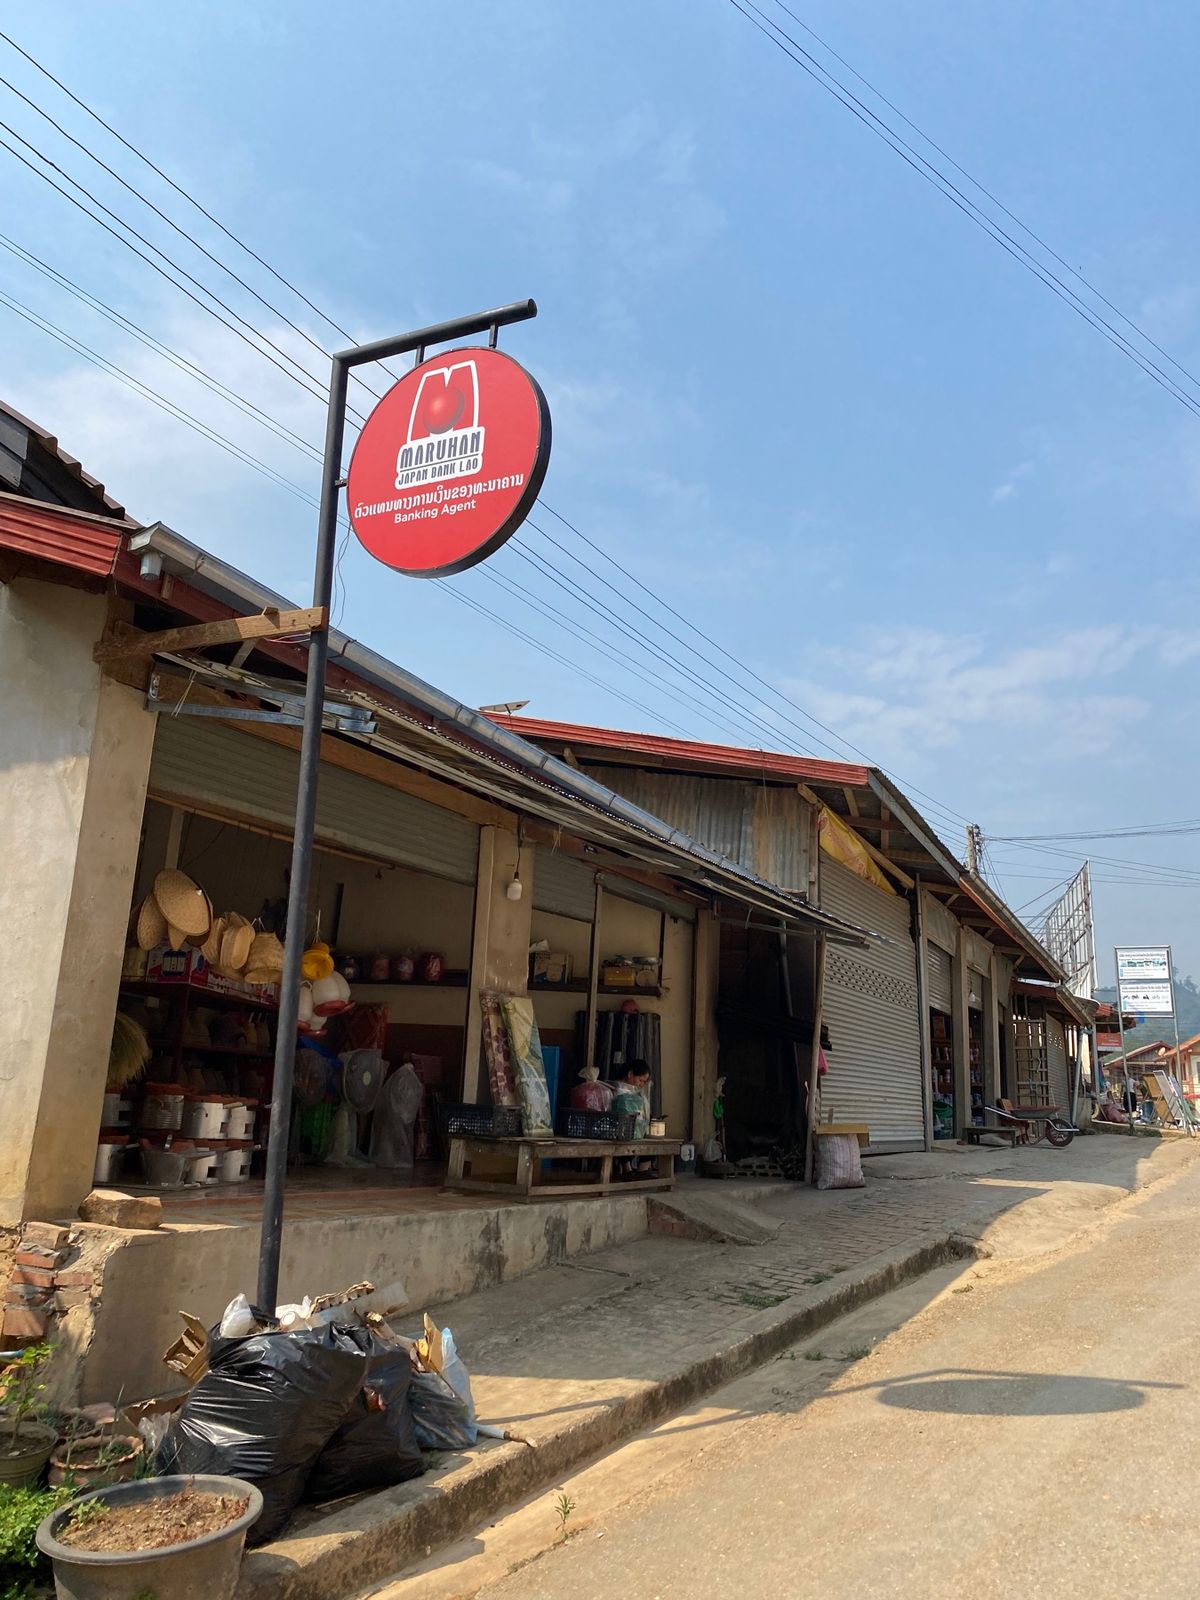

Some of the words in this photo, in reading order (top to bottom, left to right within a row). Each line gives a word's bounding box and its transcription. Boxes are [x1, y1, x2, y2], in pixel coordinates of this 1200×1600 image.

[399, 431, 481, 469] MARUHAN
[398, 469, 428, 485] JAPAN
[431, 462, 456, 478] BANK
[459, 458, 479, 473] LAO
[394, 508, 438, 524] Banking
[441, 499, 476, 516] Agent
